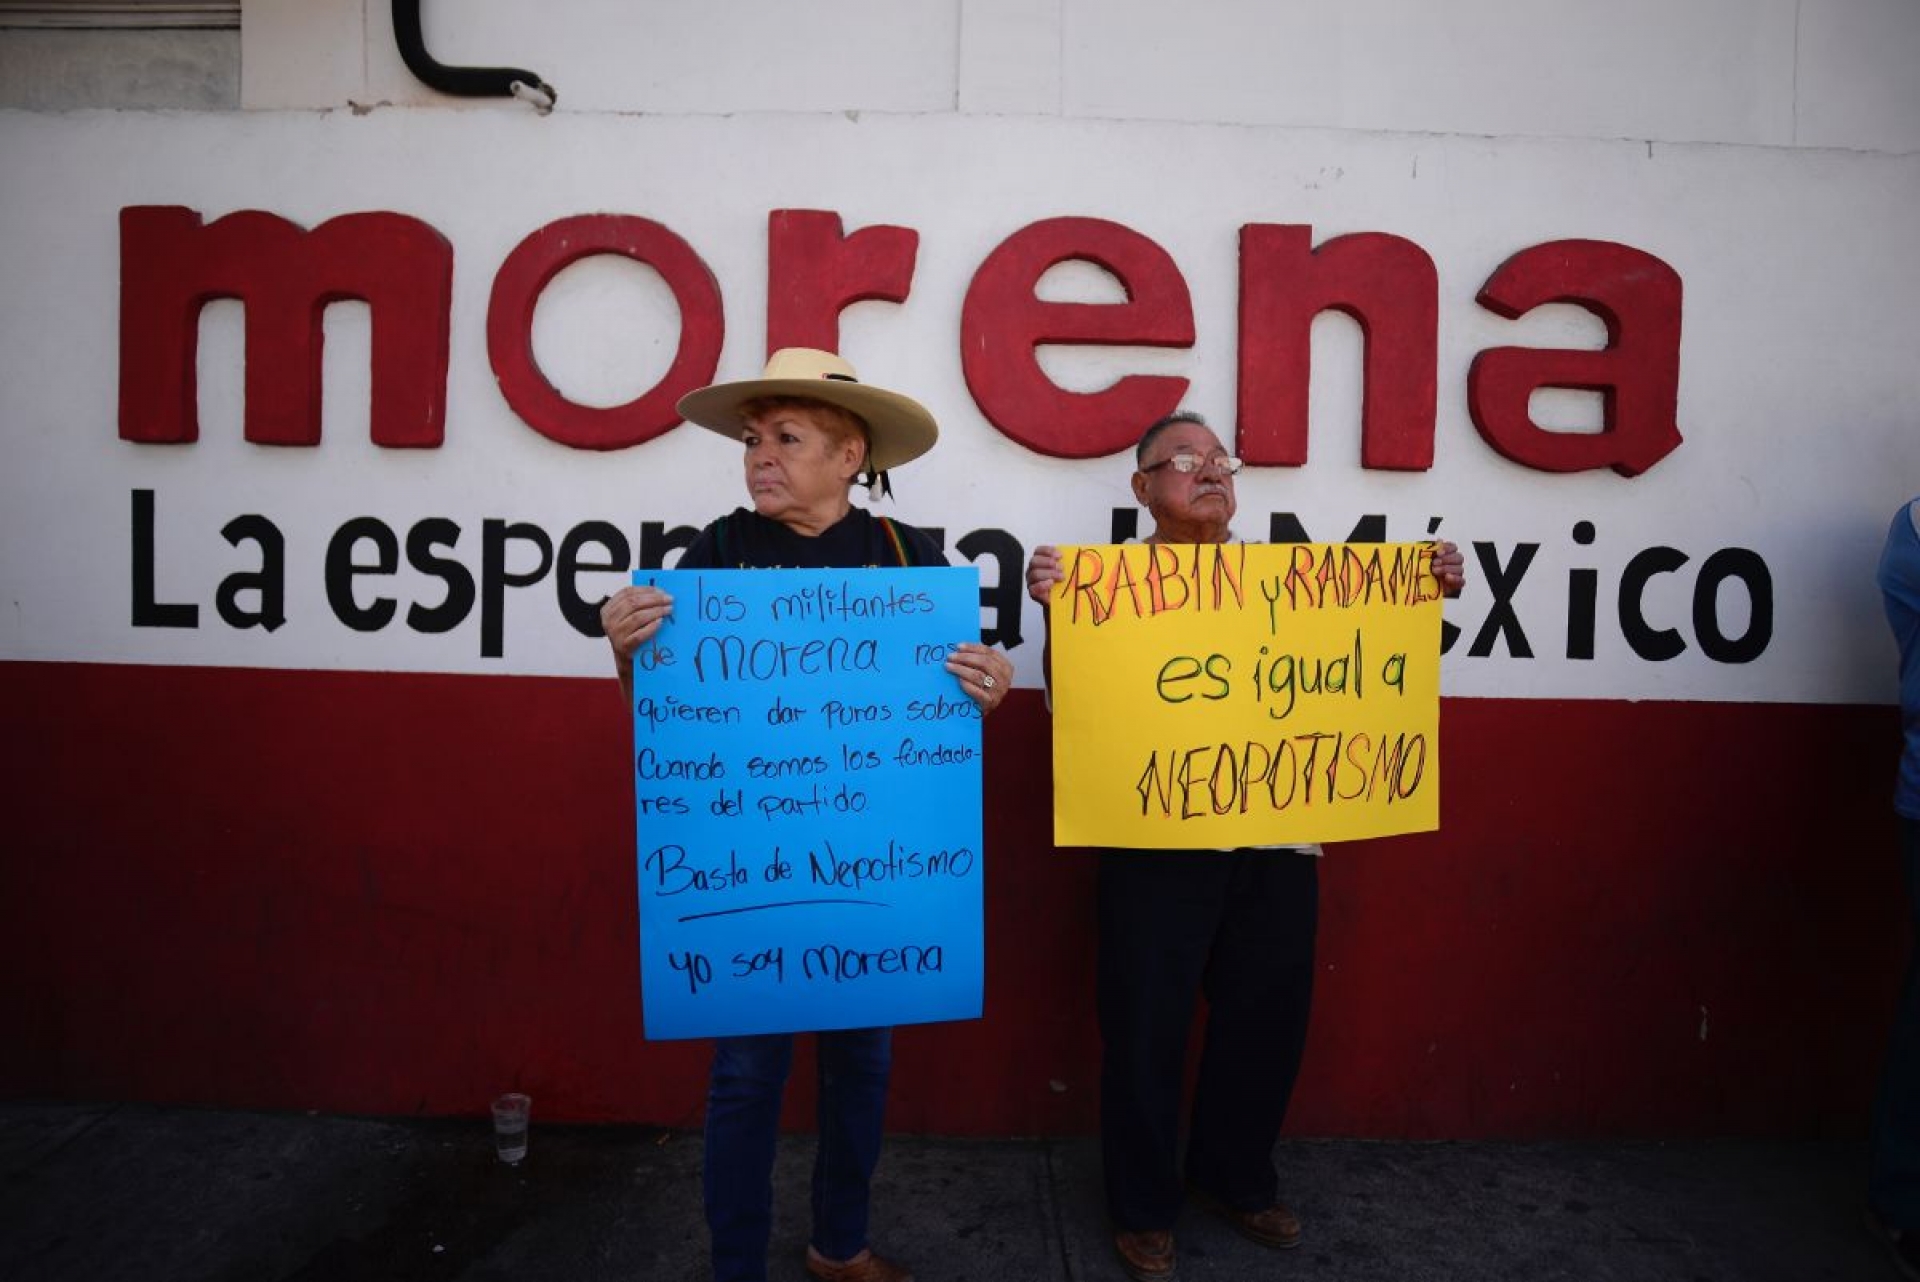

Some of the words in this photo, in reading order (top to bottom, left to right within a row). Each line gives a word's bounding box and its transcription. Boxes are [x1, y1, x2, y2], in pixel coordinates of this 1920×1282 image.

[118, 204, 1684, 478] morena
[131, 489, 287, 632] La
[1061, 541, 1246, 626] RABIN
[697, 575, 746, 622] los
[771, 580, 935, 623] militantes
[640, 636, 678, 671] de
[1157, 653, 1231, 703] es
[1253, 629, 1362, 720] igual
[1382, 653, 1407, 695] a
[637, 695, 741, 733] quieren
[767, 695, 807, 725] dar
[638, 748, 726, 780] Cuando
[747, 756, 828, 779] somos
[842, 743, 881, 772] los
[1137, 732, 1427, 820] NEOPOTISMO
[641, 796, 690, 815] res
[711, 788, 743, 816] del
[644, 844, 748, 896] Basta
[764, 847, 793, 883] de
[732, 946, 784, 983] soy
